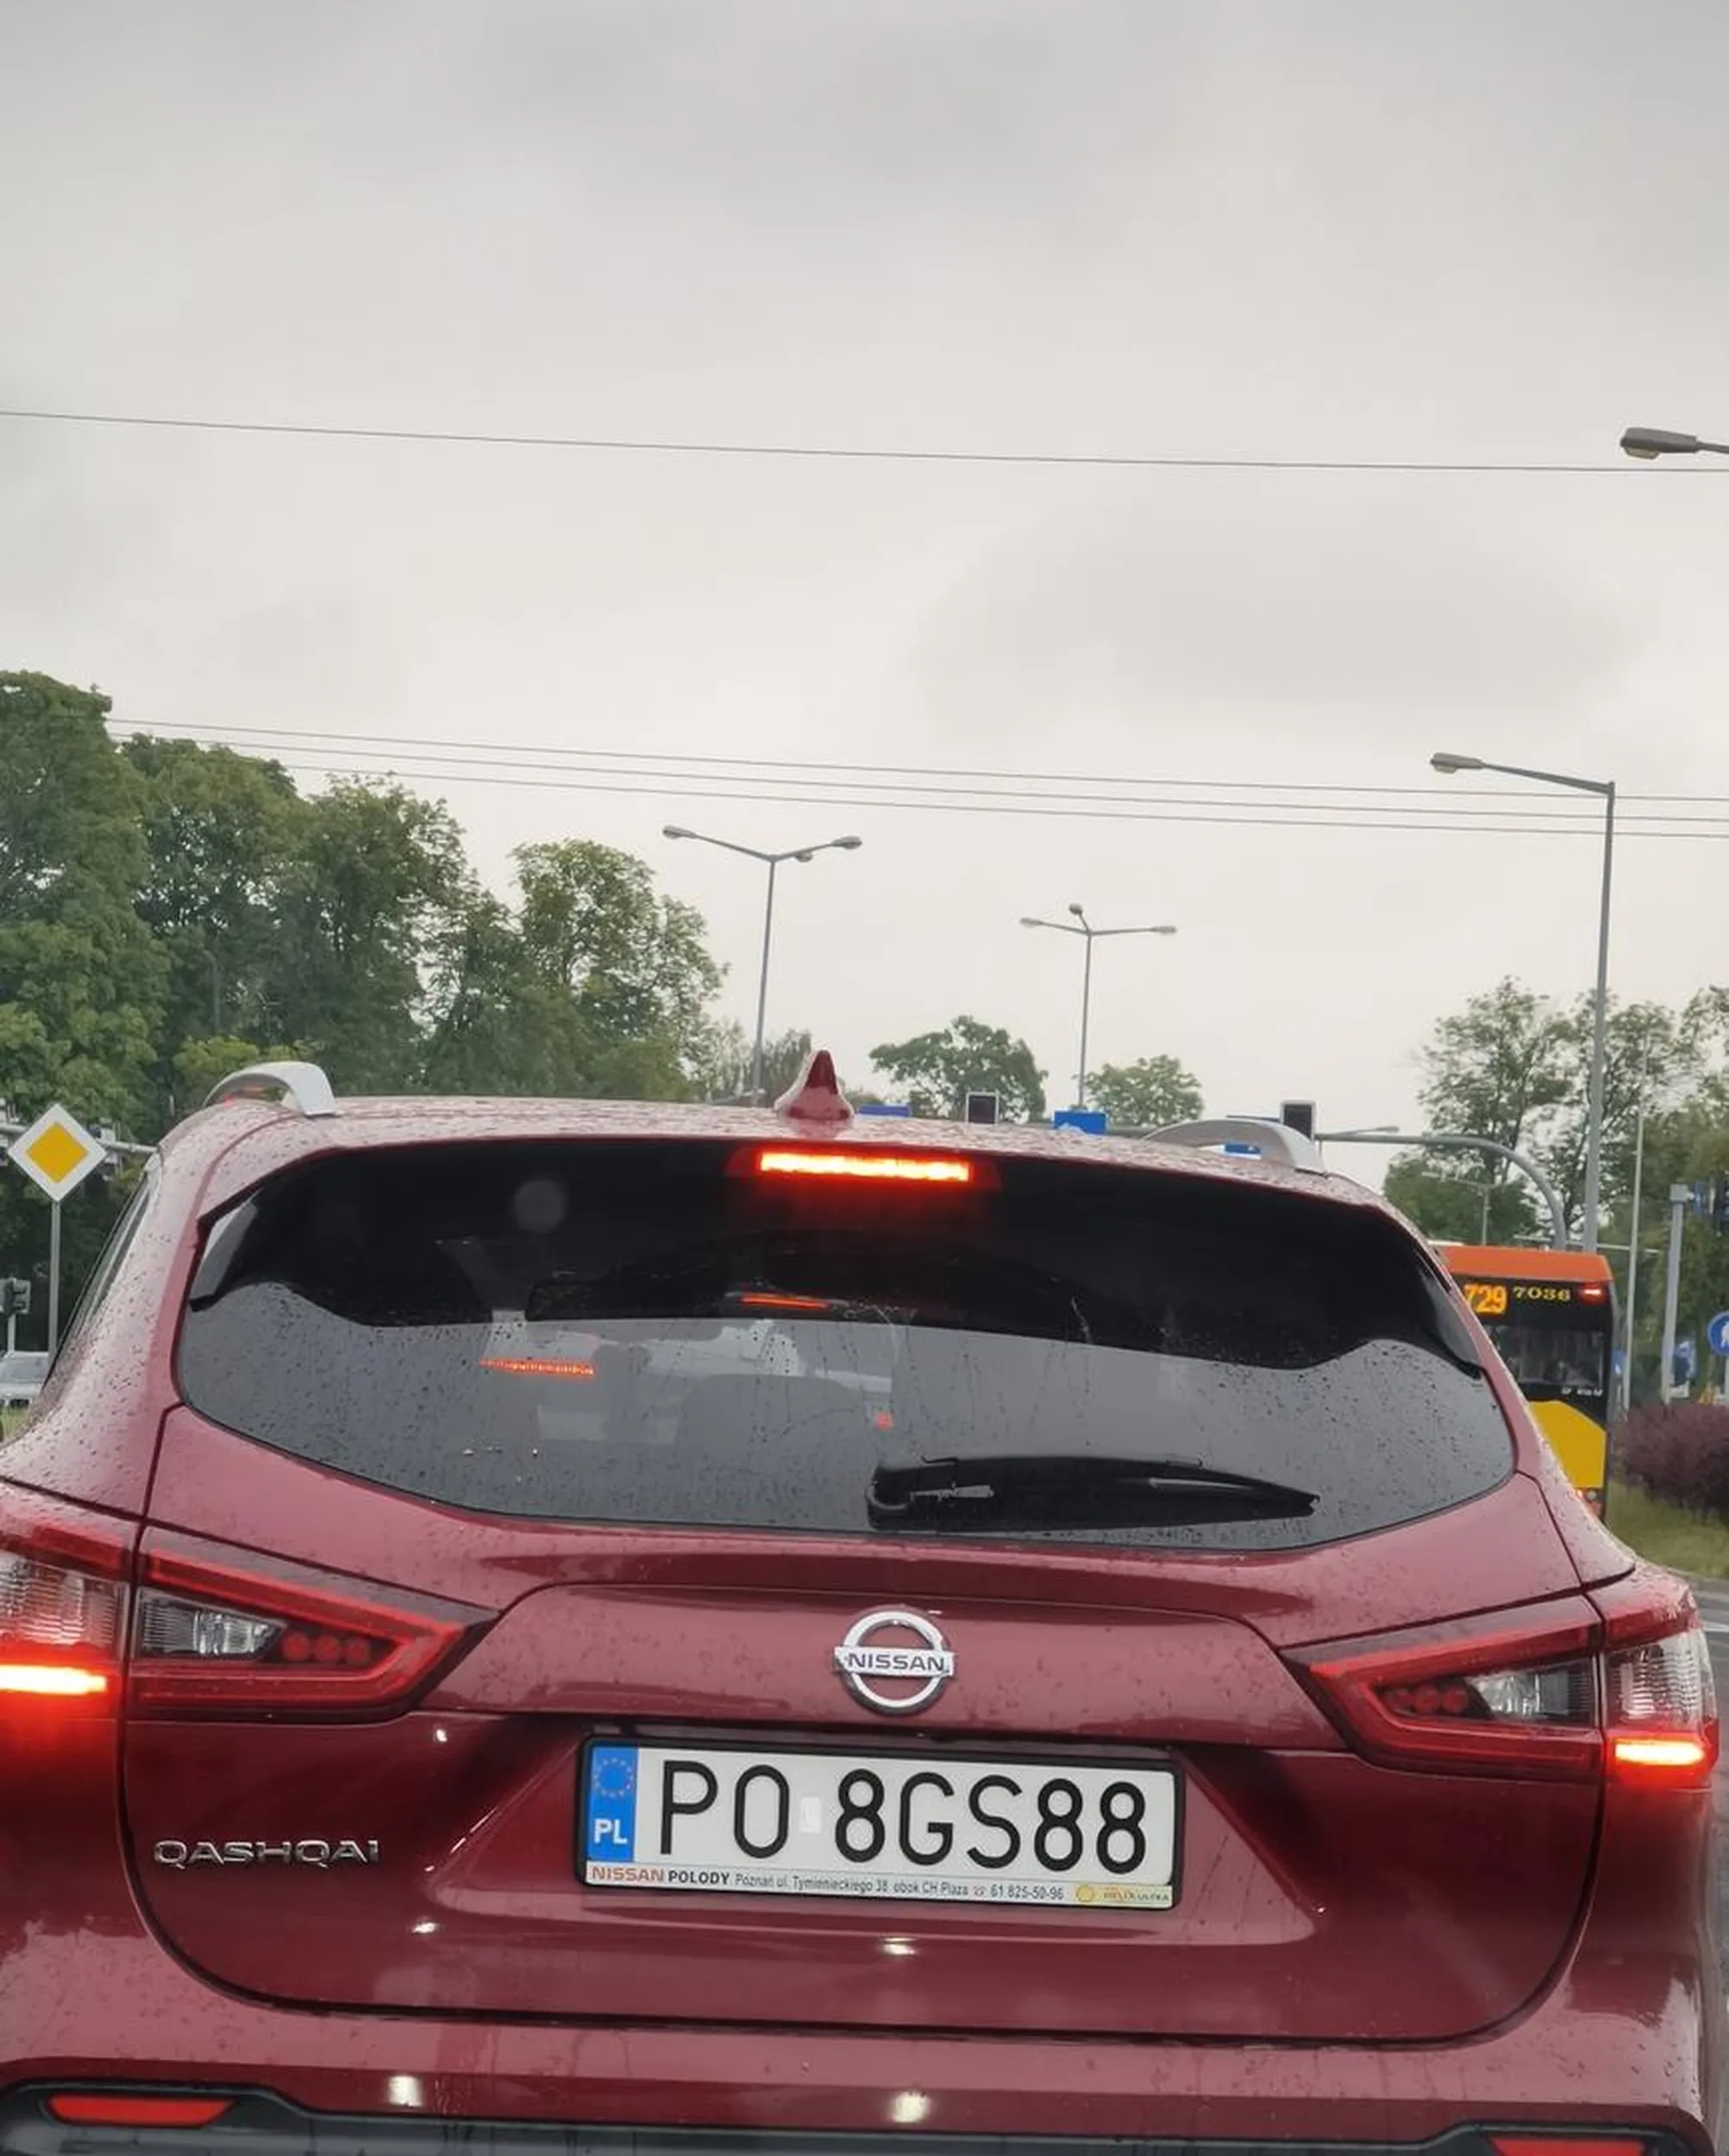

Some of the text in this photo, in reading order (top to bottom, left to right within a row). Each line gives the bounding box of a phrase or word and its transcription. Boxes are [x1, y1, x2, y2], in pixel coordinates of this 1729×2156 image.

[1463, 1283, 1507, 1314] 729
[1513, 1286, 1571, 1302] 7036
[848, 1653, 945, 1671] NISSAN
[593, 1817, 629, 1845] PL
[660, 1760, 1146, 1875] PO 8GS88
[153, 1839, 379, 1870] QASHQAI
[592, 1865, 665, 1883] NISSAN
[667, 1869, 730, 1886] POLODY
